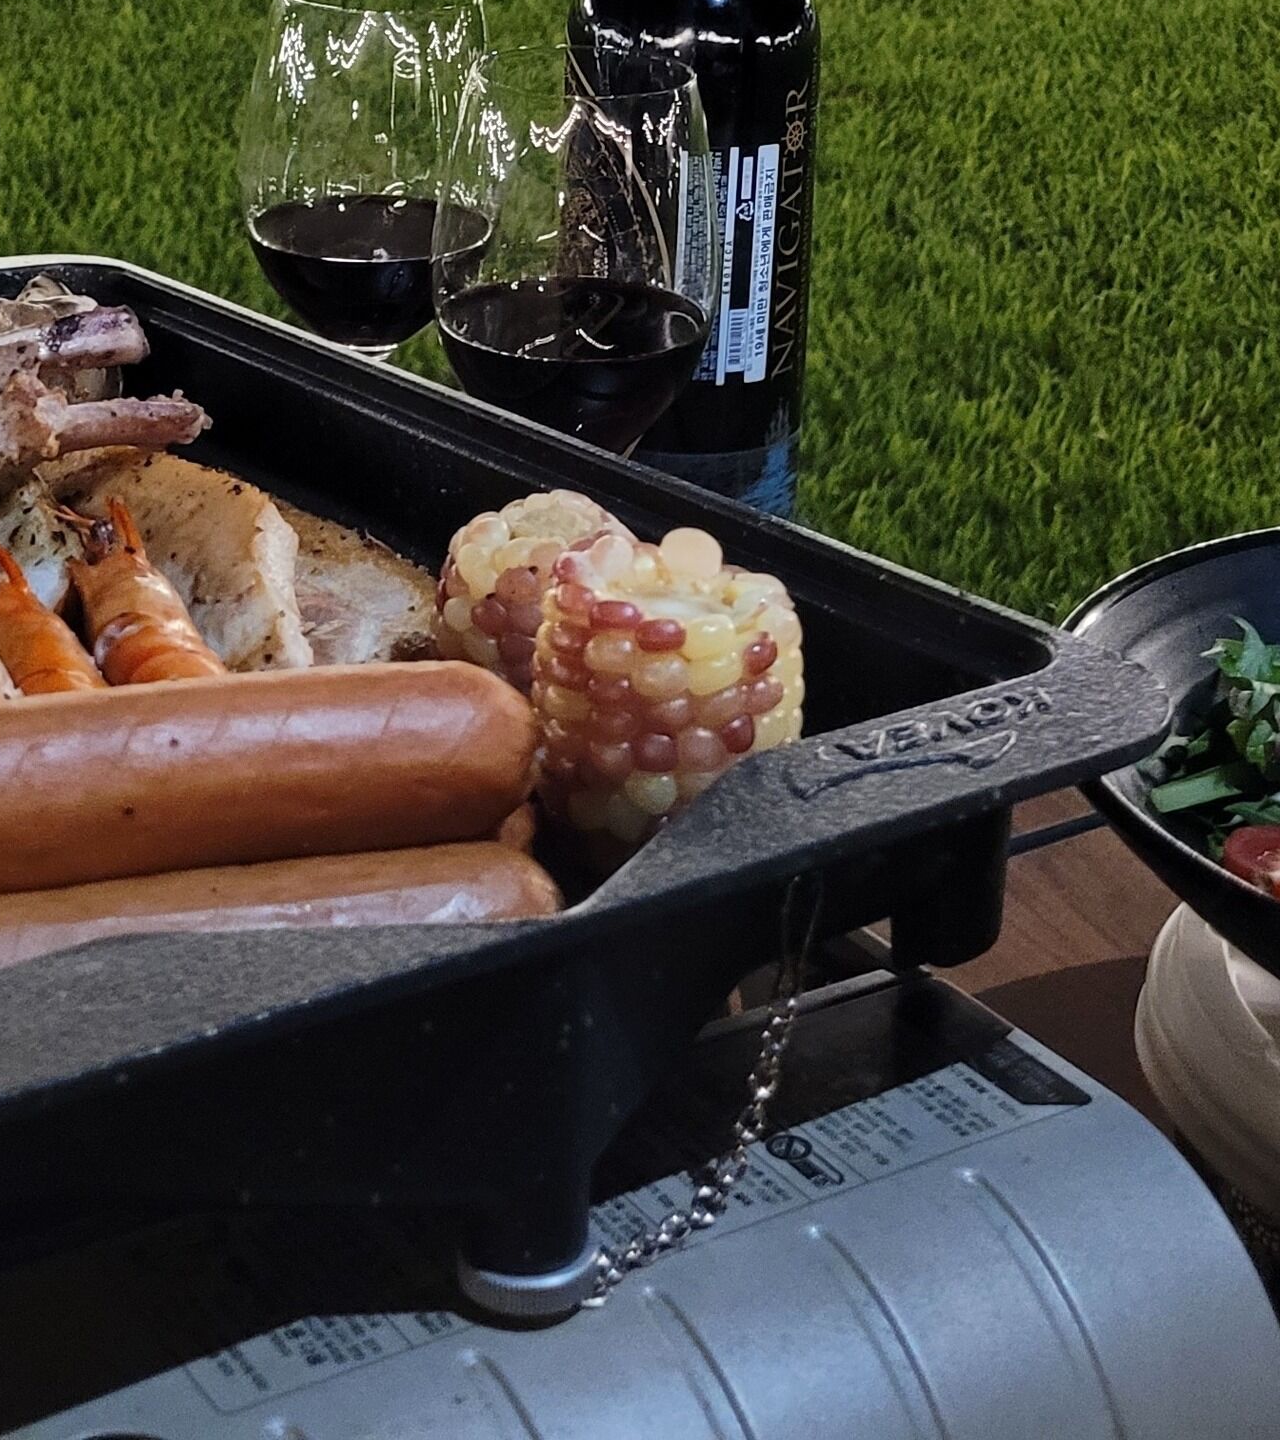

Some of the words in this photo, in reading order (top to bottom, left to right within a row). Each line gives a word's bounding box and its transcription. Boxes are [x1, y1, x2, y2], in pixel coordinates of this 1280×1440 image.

[762, 168, 776, 221] 판매금지
[722, 240, 733, 296] ENOTECA
[758, 226, 773, 292] 청소년에게
[756, 298, 768, 325] 미만
[754, 329, 766, 357] 19세
